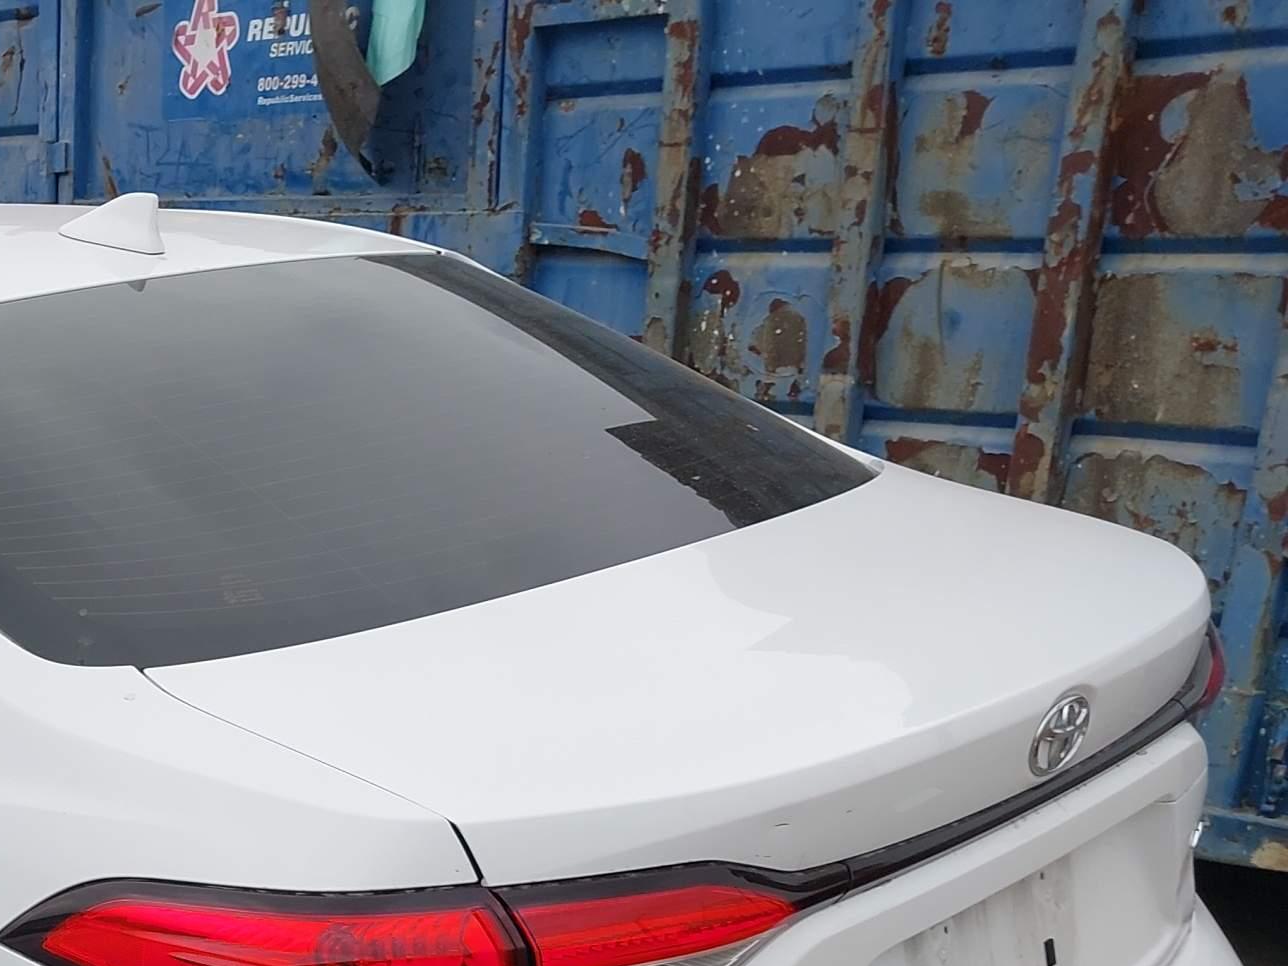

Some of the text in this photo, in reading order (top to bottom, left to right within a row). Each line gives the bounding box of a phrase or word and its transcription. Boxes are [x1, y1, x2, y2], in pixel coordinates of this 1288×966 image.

[246, 6, 360, 42] REUC
[269, 40, 314, 58] SERVIC
[257, 74, 319, 92] 800-299-4
[257, 93, 324, 106] RepublicServices
